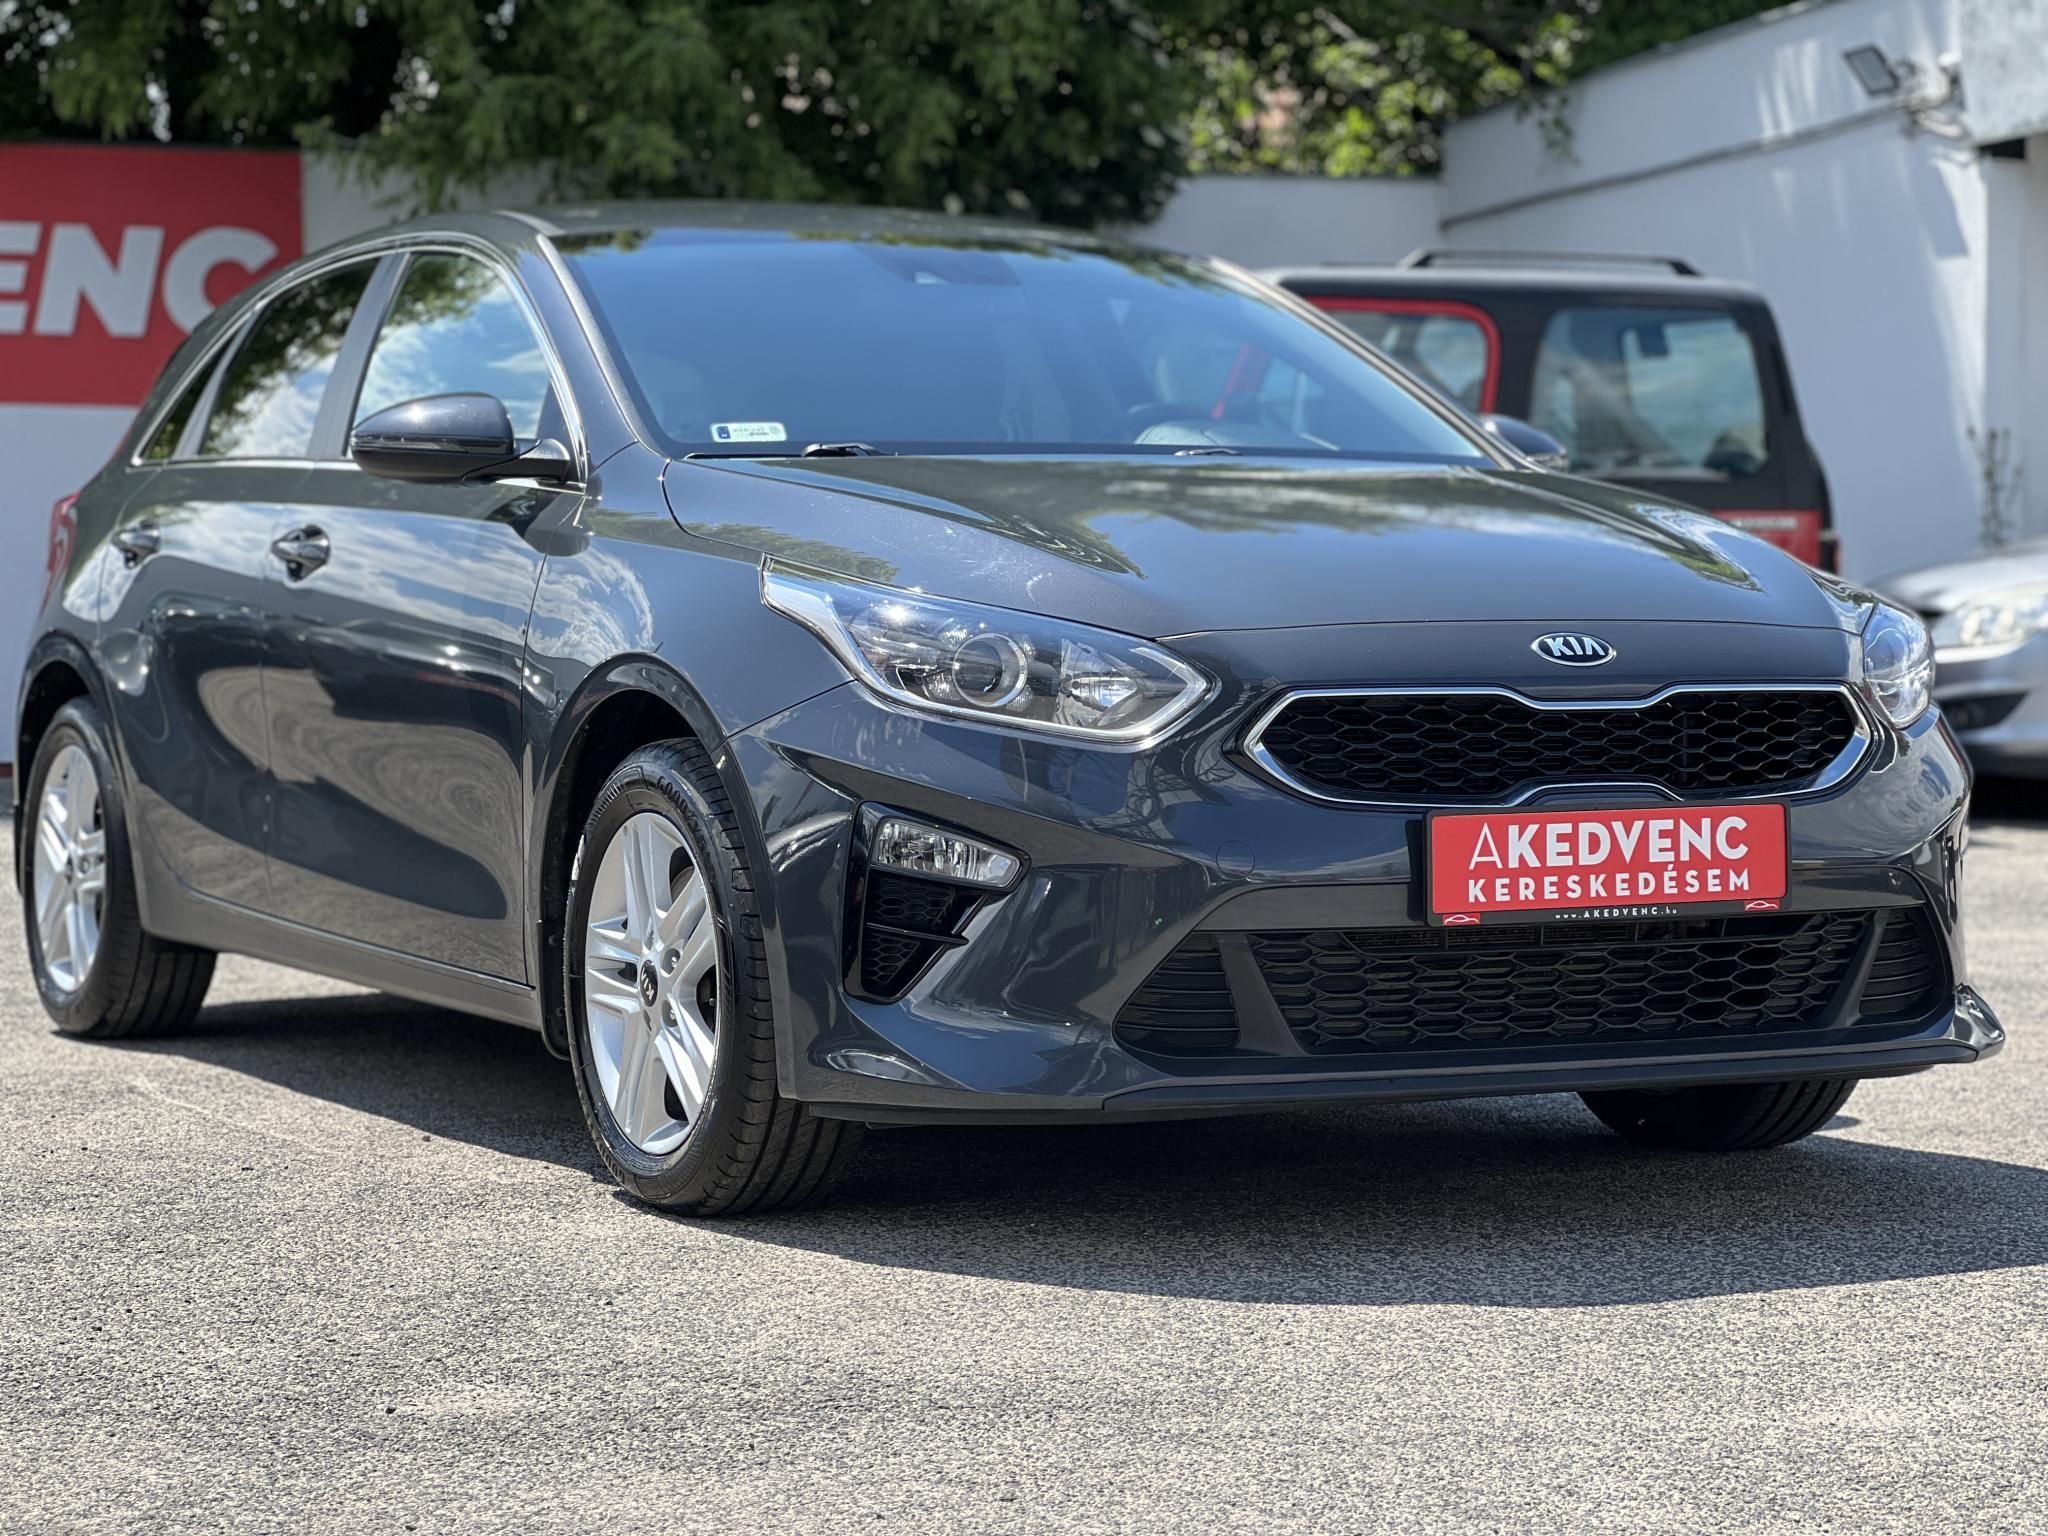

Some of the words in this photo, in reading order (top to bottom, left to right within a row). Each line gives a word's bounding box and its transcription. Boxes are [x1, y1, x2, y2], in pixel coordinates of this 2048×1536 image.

[1543, 636, 1606, 657] KIA
[1468, 816, 1749, 871] AKEDVENC
[1468, 864, 1750, 903] KERESKEDÉSEM
[1555, 906, 1677, 919] www.AKEDVENC.hu
